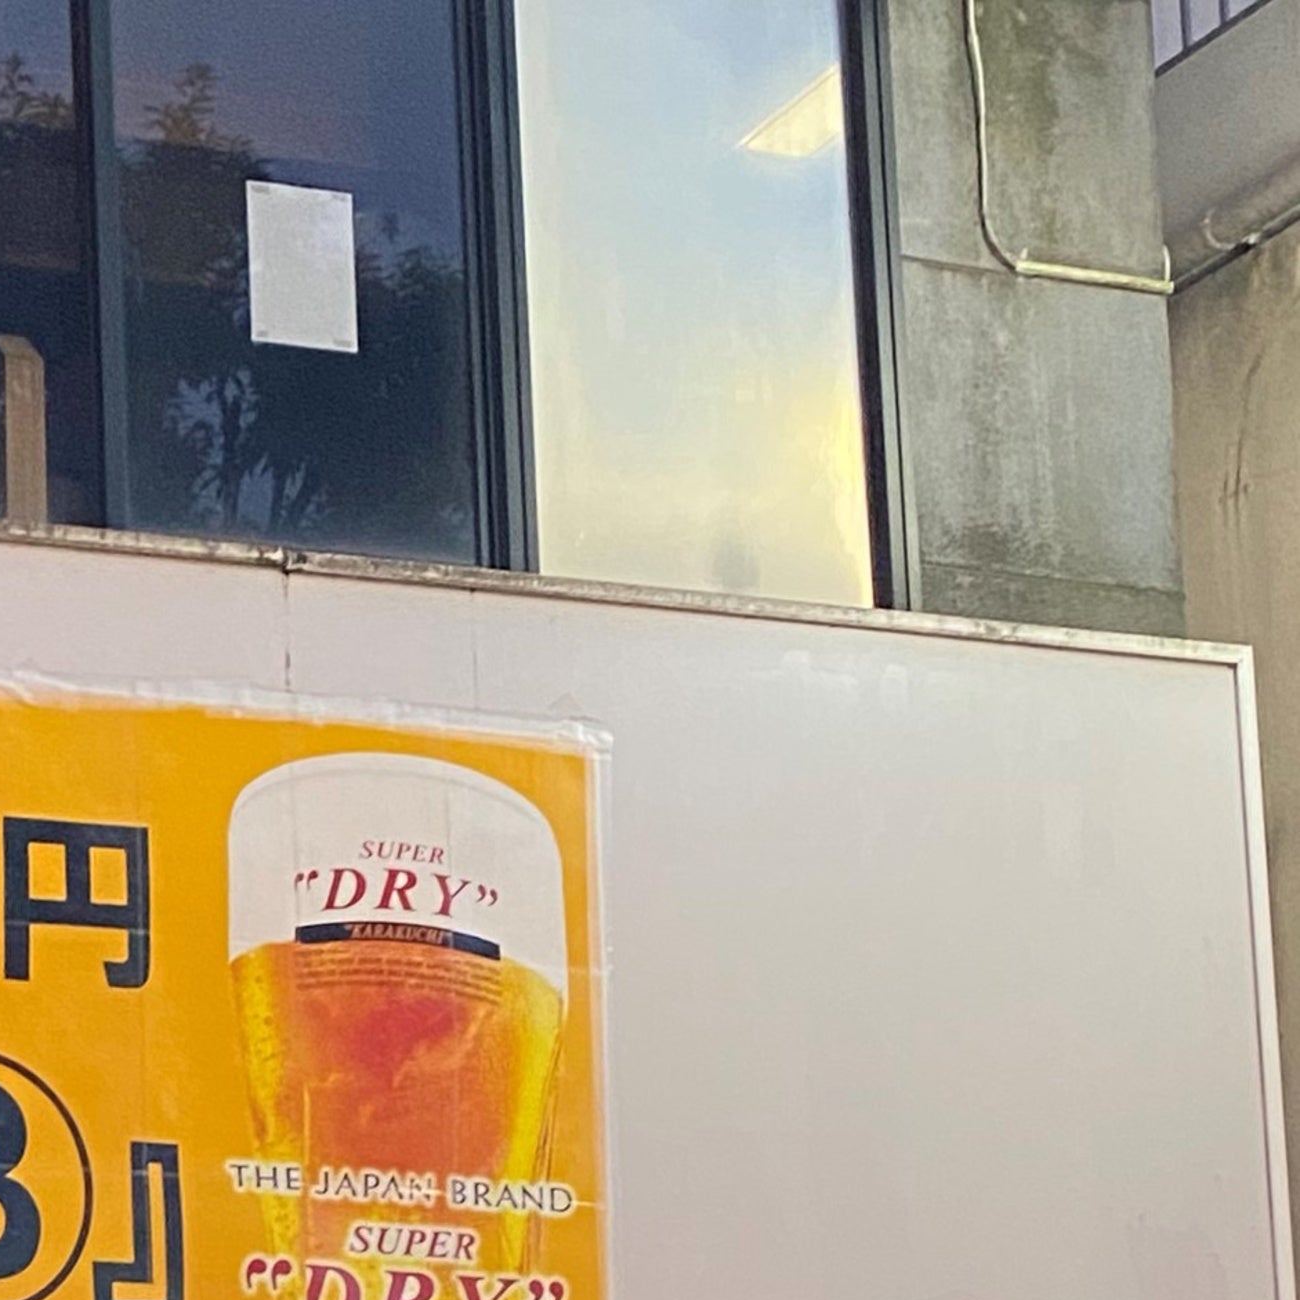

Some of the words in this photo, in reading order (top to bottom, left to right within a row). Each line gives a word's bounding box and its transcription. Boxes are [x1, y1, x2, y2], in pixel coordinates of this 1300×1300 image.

[359, 839, 445, 864] SUPER
[230, 1164, 301, 1191] THE
[314, 1170, 432, 1202] JAPAN
[451, 1178, 573, 1213] BRAND
[349, 1225, 475, 1259] SUPER
